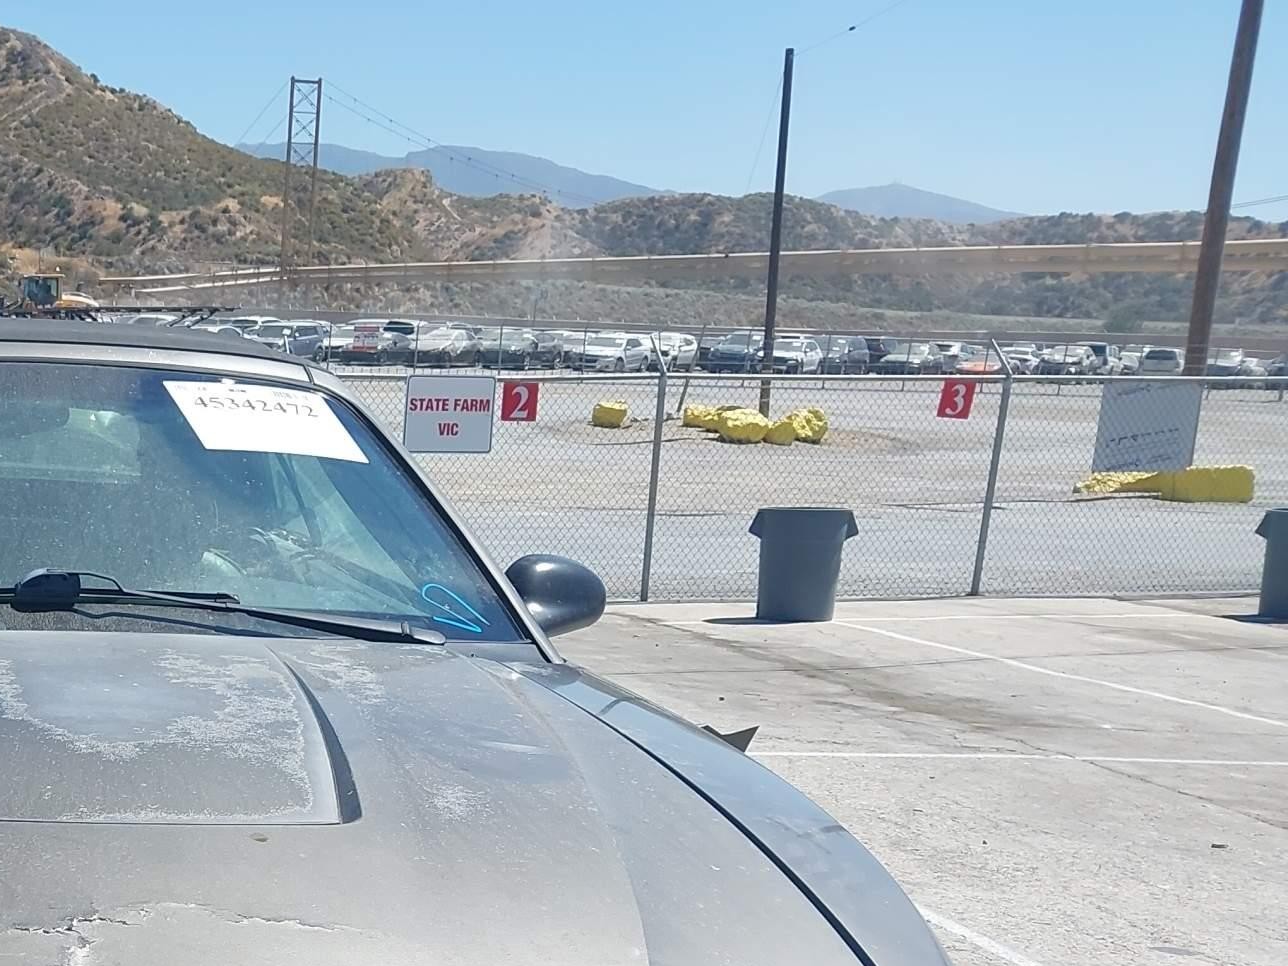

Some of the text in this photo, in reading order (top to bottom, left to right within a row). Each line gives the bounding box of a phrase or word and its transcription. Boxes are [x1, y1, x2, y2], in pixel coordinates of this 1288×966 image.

[194, 396, 319, 418] 45342472
[409, 397, 491, 413] STATE FARM
[510, 386, 529, 419] 2
[945, 384, 966, 415] 3
[438, 422, 459, 436] VIC
